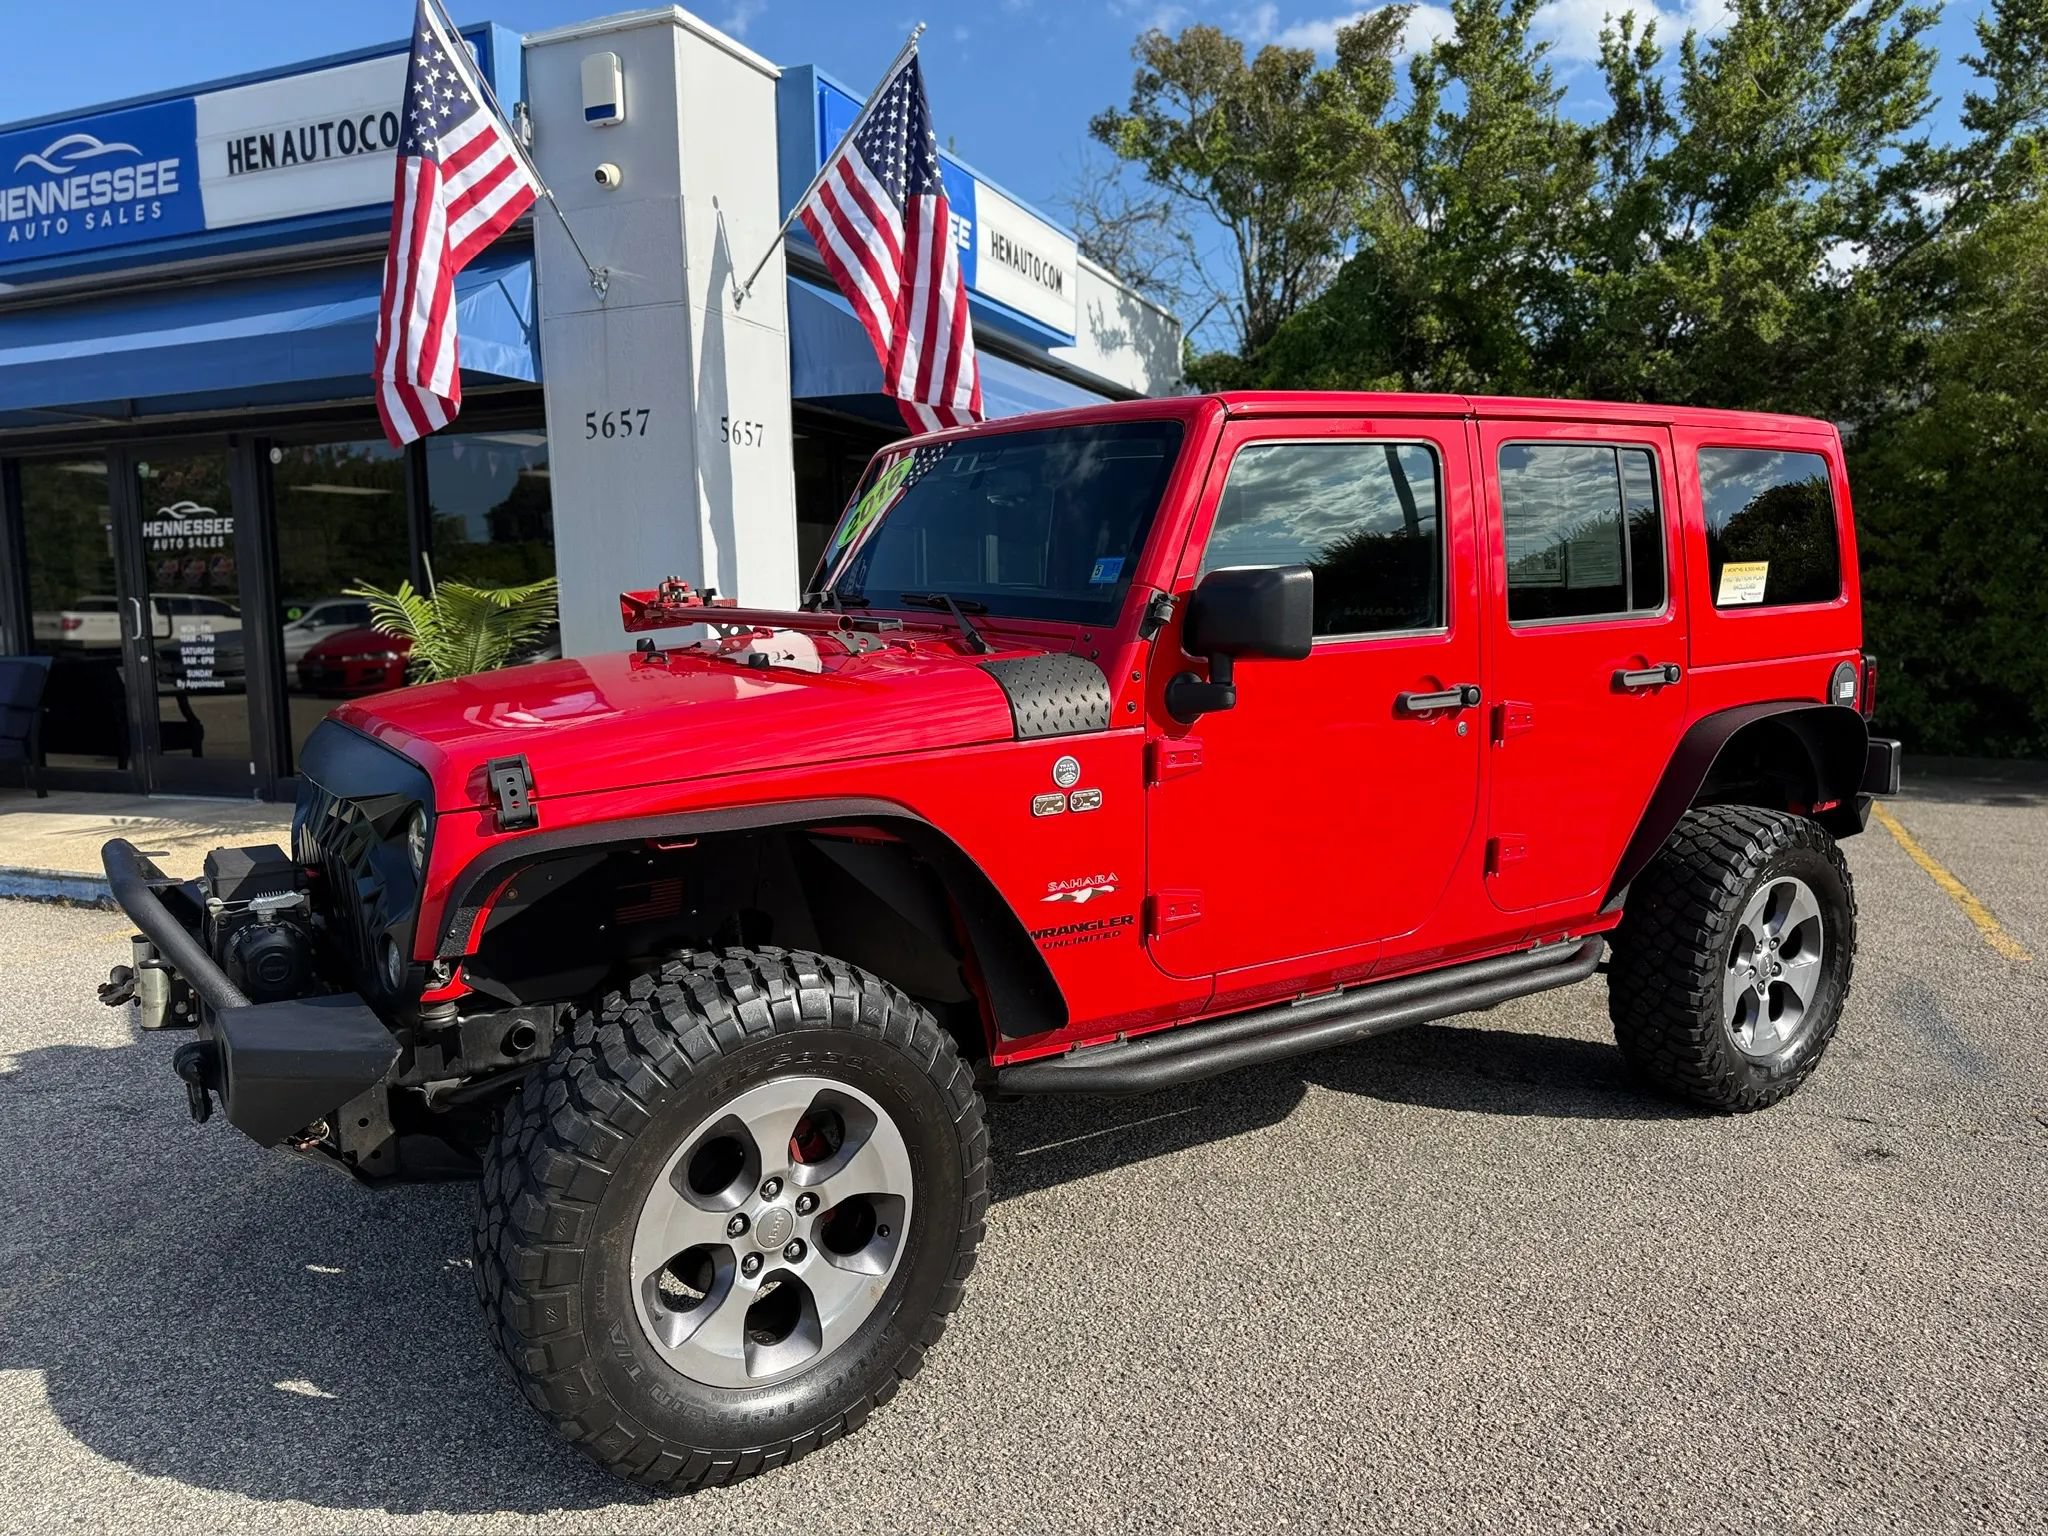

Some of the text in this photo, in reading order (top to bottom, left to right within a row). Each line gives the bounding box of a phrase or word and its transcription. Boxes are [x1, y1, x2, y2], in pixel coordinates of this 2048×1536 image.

[227, 110, 400, 175] HENAUTO.CO
[7, 201, 162, 243] AUTO SALES
[585, 407, 651, 440] 5657
[720, 415, 764, 448] 5657
[142, 518, 235, 537] HENNESSEE
[153, 536, 225, 551] AUTO SALES
[181, 646, 215, 656] SATURDAY
[186, 669, 213, 678] SUNDAY
[186, 679, 226, 690] Appointment
[1047, 872, 1119, 892] SAHARA
[1030, 915, 1134, 940] WRANGLER
[1042, 930, 1121, 950] UNLIMITED
